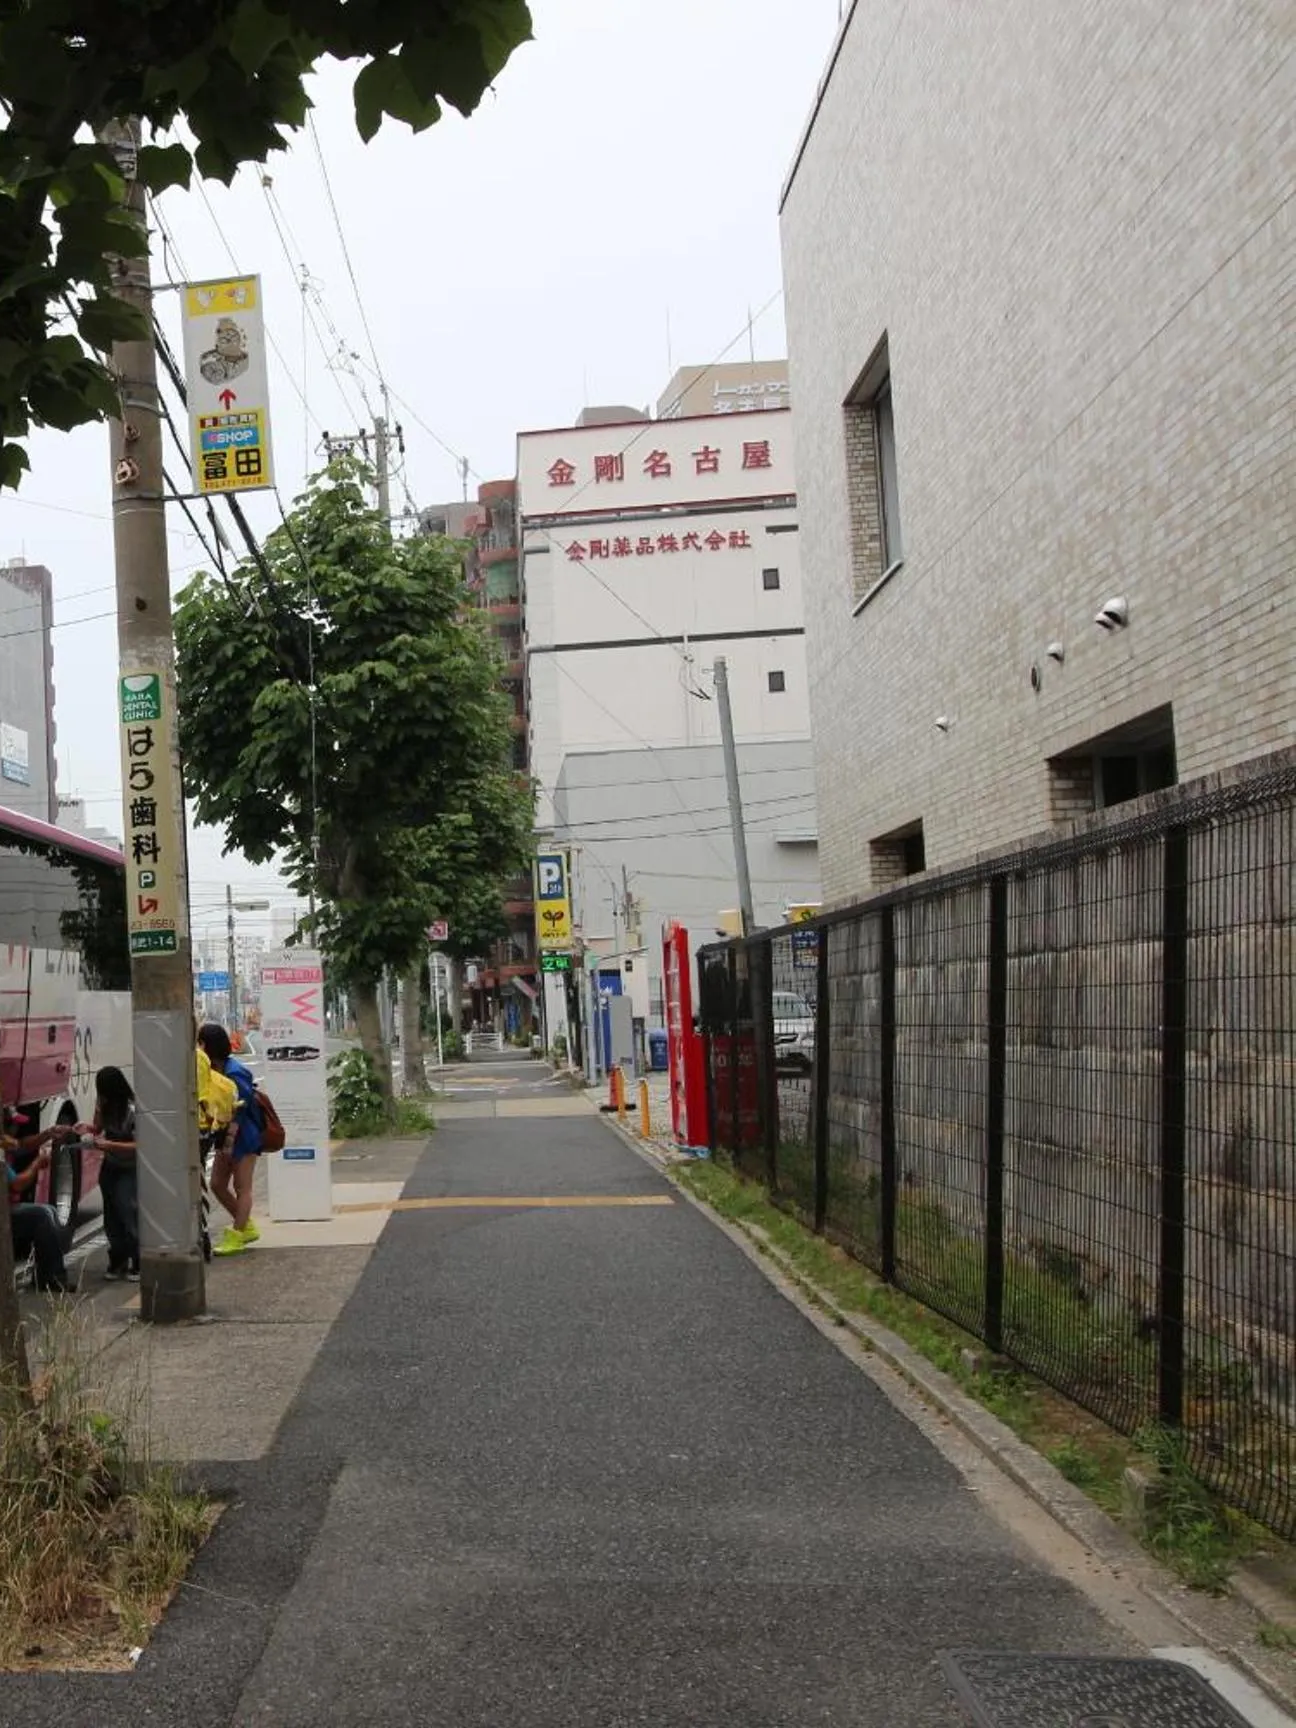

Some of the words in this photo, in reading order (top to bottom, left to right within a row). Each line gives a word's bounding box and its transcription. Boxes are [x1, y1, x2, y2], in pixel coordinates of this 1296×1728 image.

[202, 449, 262, 481] 富田
[547, 440, 773, 487] 金剛名古屋
[565, 529, 752, 562] 金剛薬品株式会社
[127, 727, 162, 865] はら歯科
[539, 862, 561, 895] P
